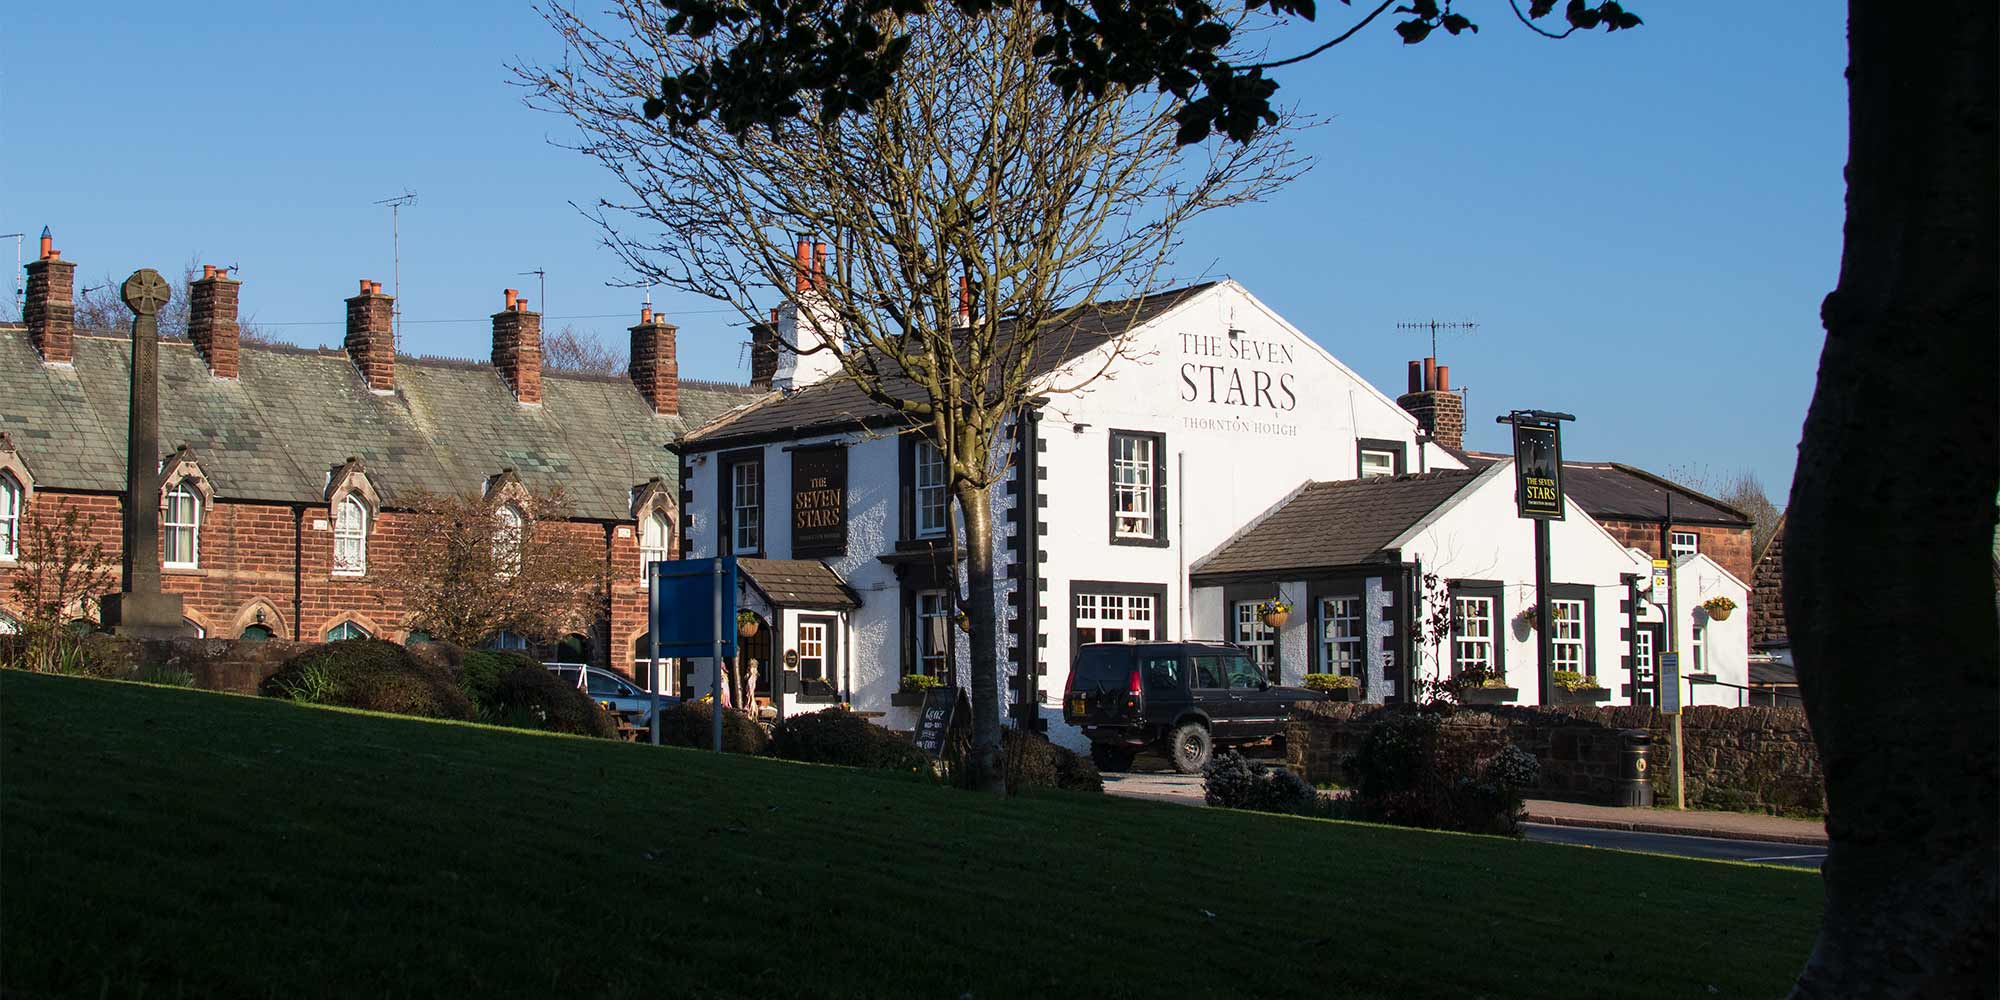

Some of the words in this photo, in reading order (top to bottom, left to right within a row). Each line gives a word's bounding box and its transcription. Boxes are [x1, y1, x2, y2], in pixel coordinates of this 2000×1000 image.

[1179, 332, 1222, 357] THE
[1229, 338, 1294, 364] SEVEN
[1181, 363, 1296, 411] STARS
[1183, 416, 1250, 433] THORNTON
[1254, 422, 1297, 437] HOUGH
[810, 477, 827, 488] THE
[1526, 477, 1538, 485] THE
[1538, 478, 1554, 486] SEVEN
[796, 489, 840, 509] SEVEN
[1527, 486, 1555, 500] STARS
[798, 508, 839, 528] STARS
